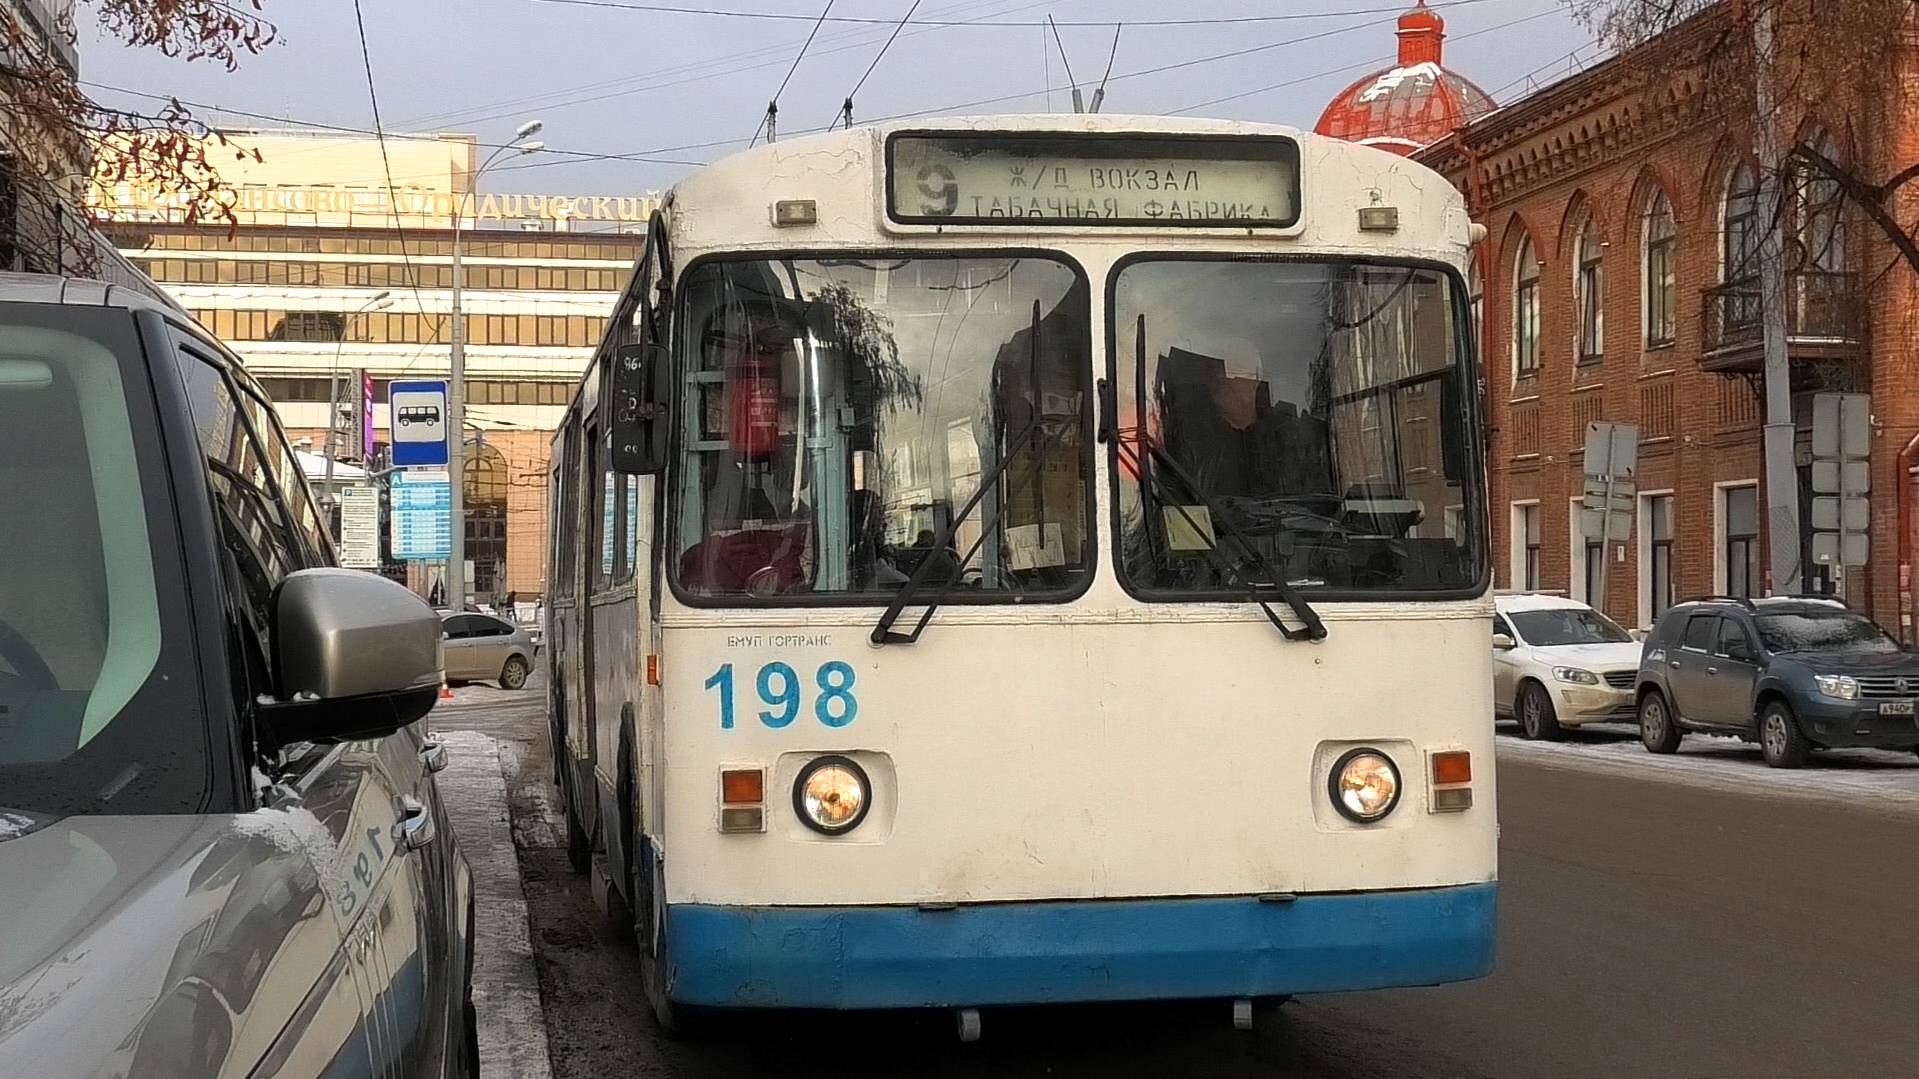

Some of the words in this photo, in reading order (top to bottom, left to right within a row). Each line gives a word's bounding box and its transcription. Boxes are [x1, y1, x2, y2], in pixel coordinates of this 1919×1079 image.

[916, 164, 958, 215] 9
[1009, 165, 1070, 190] Ж/Д
[1090, 167, 1199, 192] ВОКЗАЛ
[970, 195, 1119, 218] ТАБАЧНАЯ
[768, 635, 832, 648] ГОРТРАНС
[704, 660, 859, 730] 198
